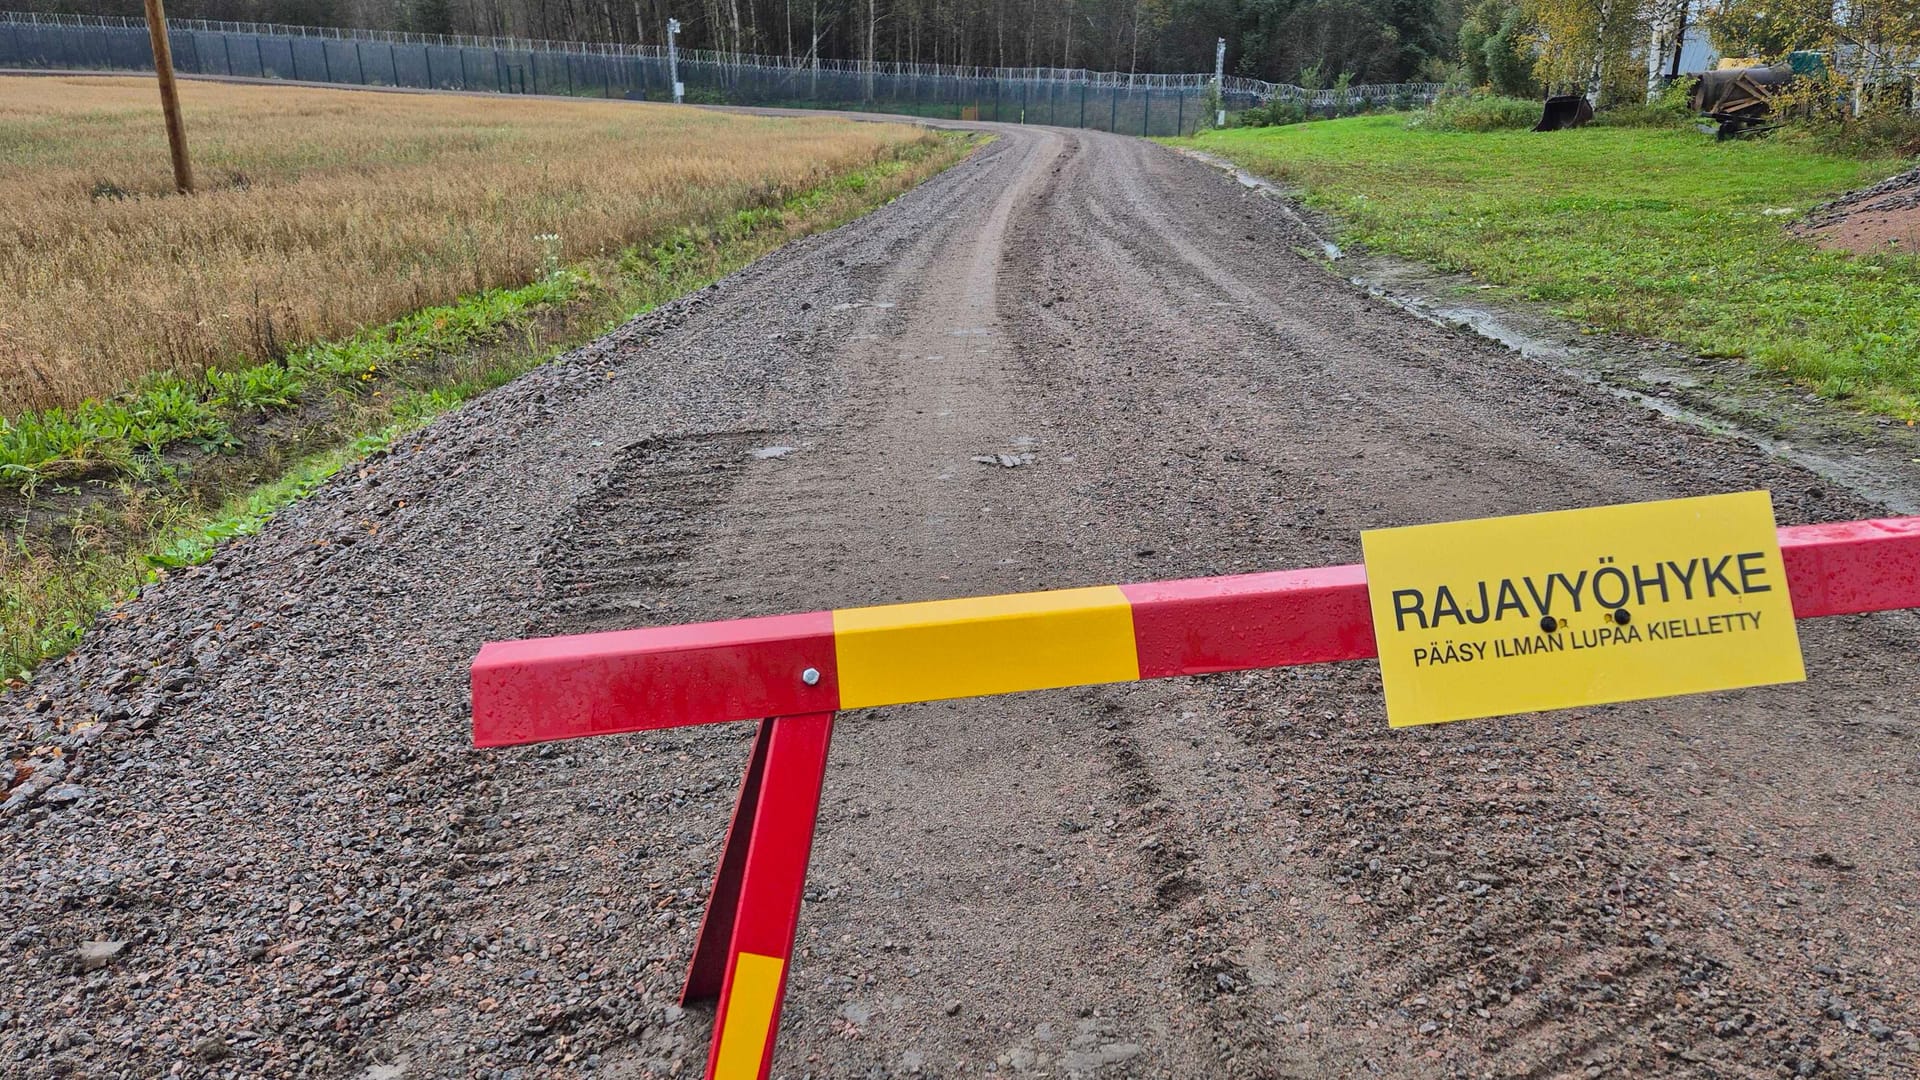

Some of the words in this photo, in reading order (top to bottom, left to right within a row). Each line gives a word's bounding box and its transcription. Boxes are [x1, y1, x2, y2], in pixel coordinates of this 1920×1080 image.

[1392, 552, 1772, 632] RAJAVYÖHYKE
[1413, 642, 1486, 667] PÄÄSY
[1494, 633, 1564, 658] ILMAN
[1570, 625, 1642, 650] LUPAA
[1648, 611, 1761, 641] KIELLETTY
